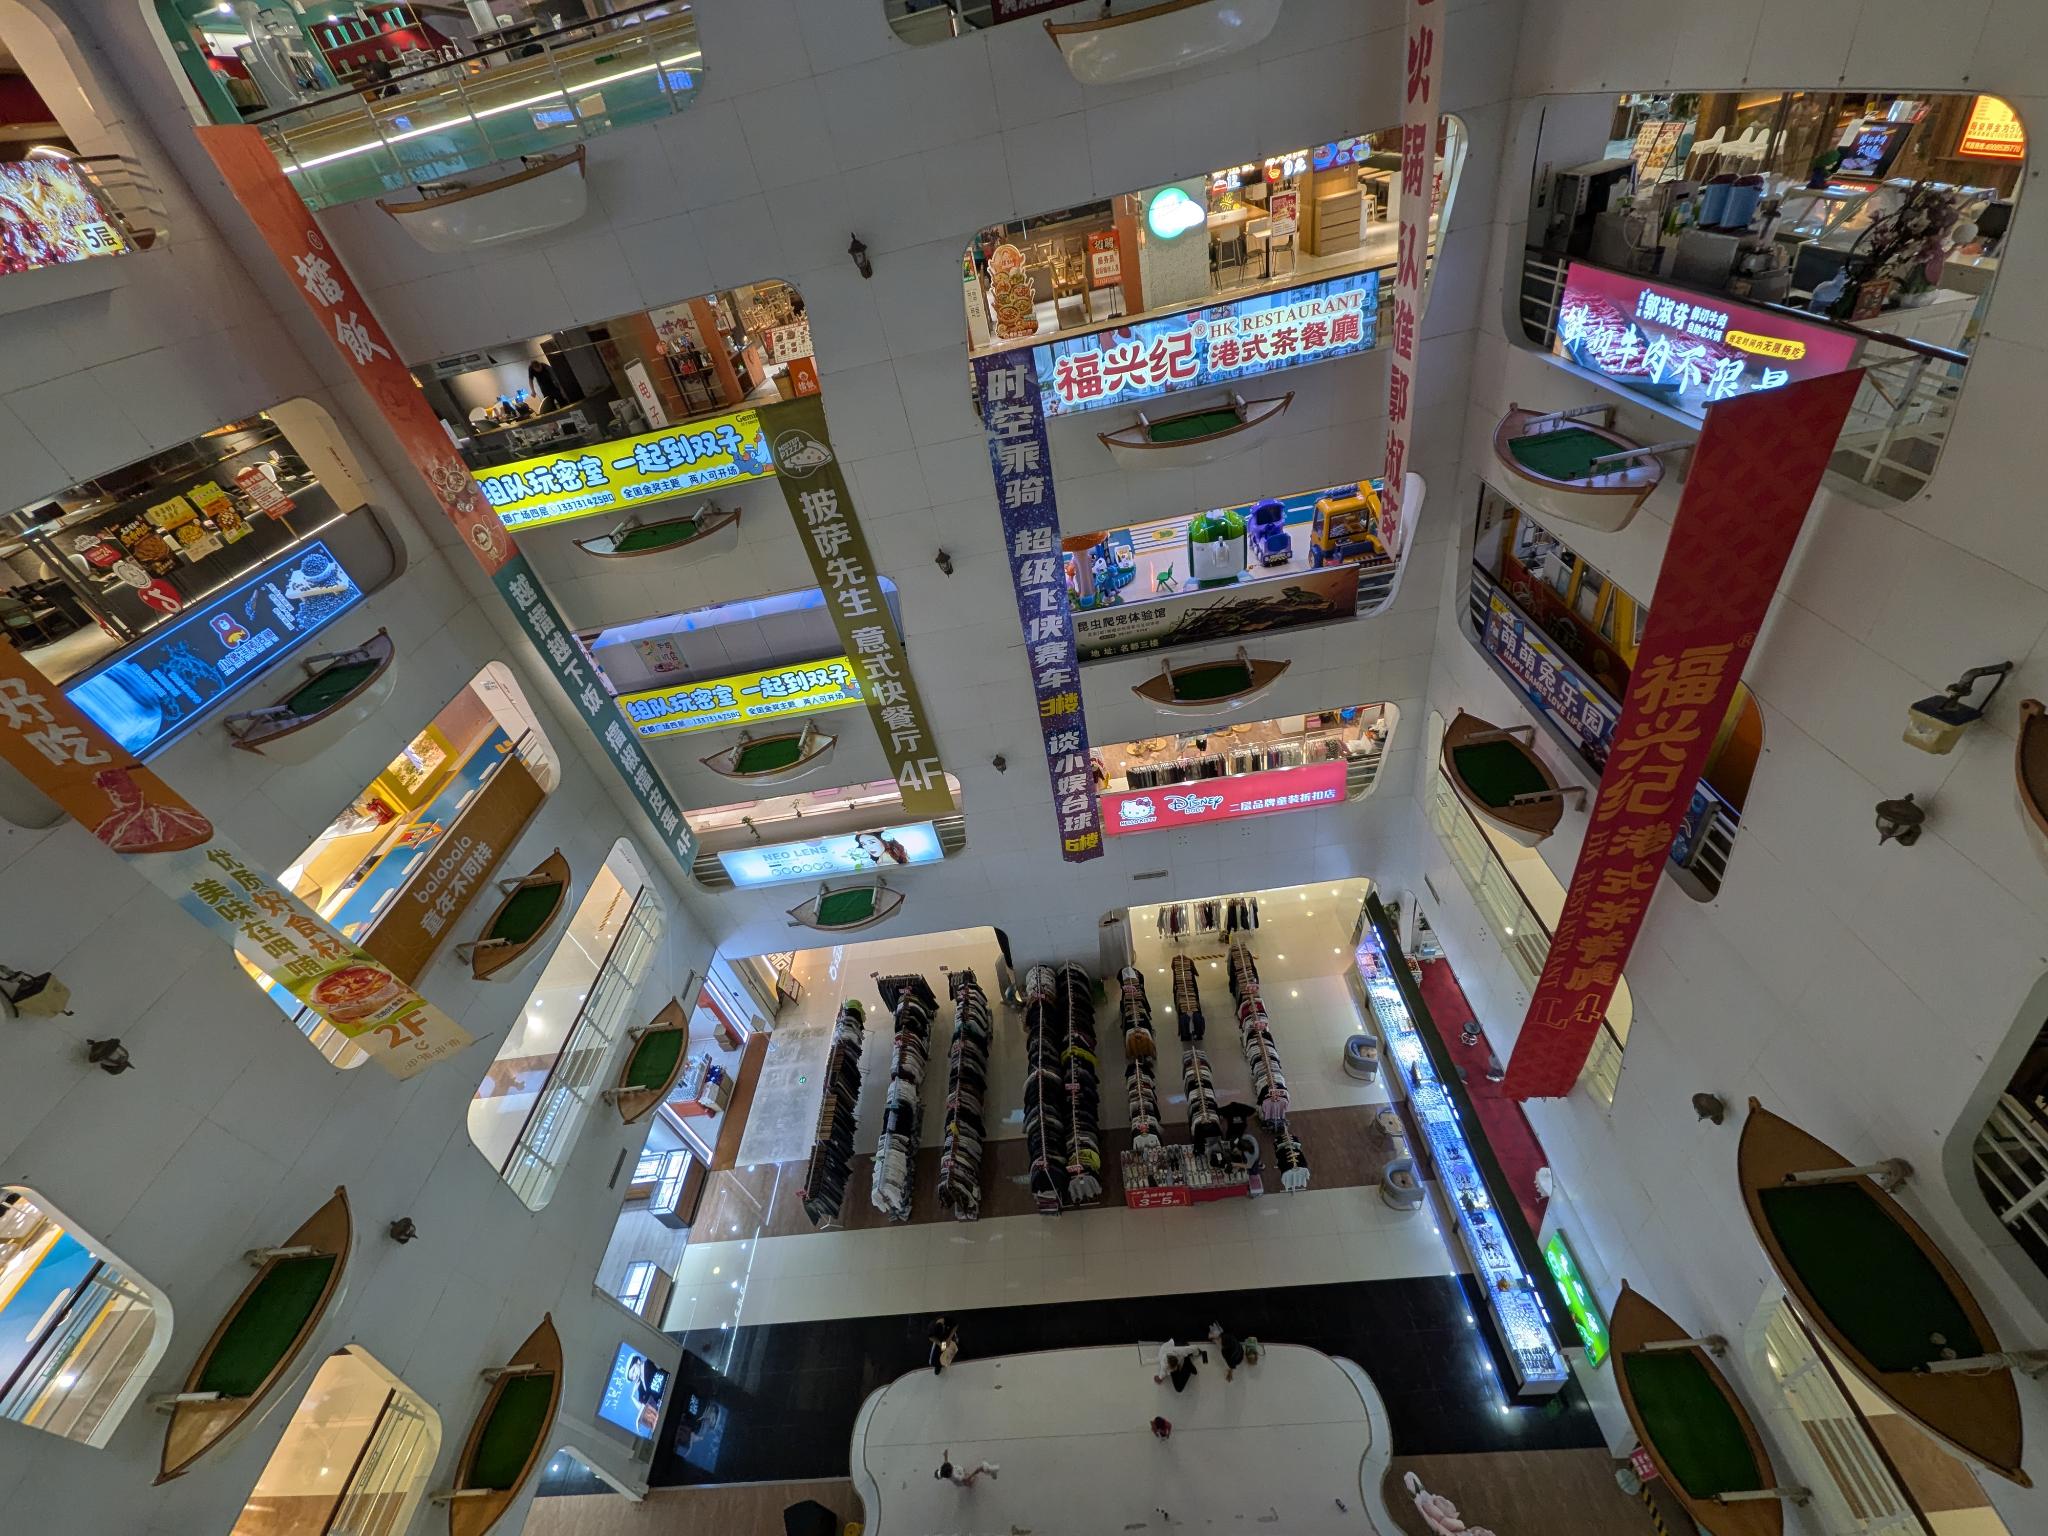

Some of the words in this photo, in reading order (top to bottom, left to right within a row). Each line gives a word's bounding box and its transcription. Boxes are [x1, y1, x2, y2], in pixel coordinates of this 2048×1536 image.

[82, 226, 119, 249] 5层
[1381, 0, 1434, 545] 火锅认准郭淑芬
[1209, 321, 1236, 339] HK
[1241, 292, 1365, 332] RESTAURANT
[1643, 292, 1690, 329] 郭淑芬
[1055, 330, 1198, 402] 福兴纪
[1209, 312, 1362, 371] 港式茶餐廳
[478, 455, 611, 508] 组队玩密室
[612, 424, 743, 474] 一起到双子
[780, 441, 804, 460] PIZZA
[987, 363, 1045, 509] 时空乘骑
[623, 476, 681, 499] 全国金奖主题
[689, 464, 738, 484] 两人可开场
[799, 486, 877, 618] 披萨先生
[851, 624, 922, 754] 意式快餐厅
[899, 757, 944, 792] 4F
[1014, 526, 1072, 689] 超级飞侠赛车
[1077, 607, 1167, 633] 昆虫爬宠体验馆
[0, 677, 113, 767] 好吃
[508, 572, 603, 717] 越擂越下饭
[676, 827, 693, 858] 4F
[626, 685, 738, 723] 组队玩密室
[741, 664, 850, 699] 一起到双子
[639, 719, 685, 735] 名都广场四层
[748, 700, 796, 716] 全国金奖主题
[803, 691, 845, 706] 两人可开场
[1039, 692, 1080, 717] 3楼
[1501, 623, 1604, 738] 萌萌兔乐园
[1503, 649, 1525, 673] HAPPY
[1524, 670, 1549, 698] GAMES
[1548, 693, 1567, 719] LOVE
[1566, 710, 1584, 732] LIFE
[1598, 642, 1736, 822] 福兴纪
[1048, 729, 1093, 833] 谈小娱台球
[1229, 788, 1337, 813] 二层品牌童装折扣店
[414, 836, 472, 904] balabala
[762, 850, 790, 862] NEO
[793, 845, 829, 858] LENS
[1064, 831, 1099, 852] 6楼
[191, 878, 327, 978] 美味在呷哺
[206, 848, 354, 962] 优质好食材
[420, 841, 494, 938] 童年不同样
[373, 1009, 429, 1050] 2F
